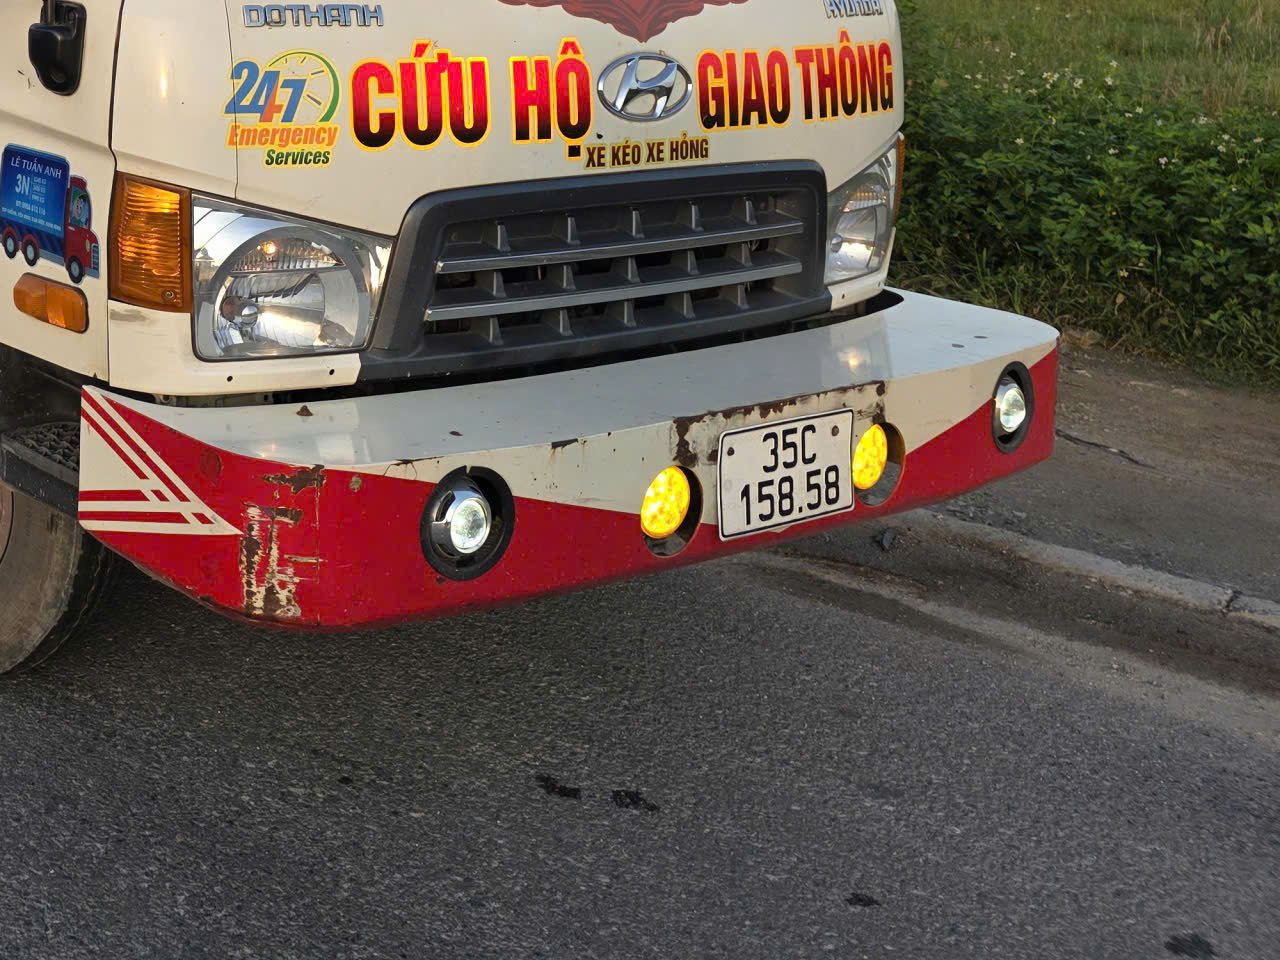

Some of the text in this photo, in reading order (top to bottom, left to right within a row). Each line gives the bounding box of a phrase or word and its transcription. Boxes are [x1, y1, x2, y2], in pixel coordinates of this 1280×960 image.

[242, 4, 384, 28] DOTHANH
[351, 28, 895, 160] CỨU HỘ GIAO THÔNG
[227, 124, 339, 148] Emergency
[264, 149, 332, 166] Services
[585, 131, 710, 169] XE KÉO XE HỎNG
[15, 173, 31, 196] 3N
[44, 166, 62, 179] ANH
[762, 424, 817, 473] 35C
[740, 464, 840, 526] 158.58
